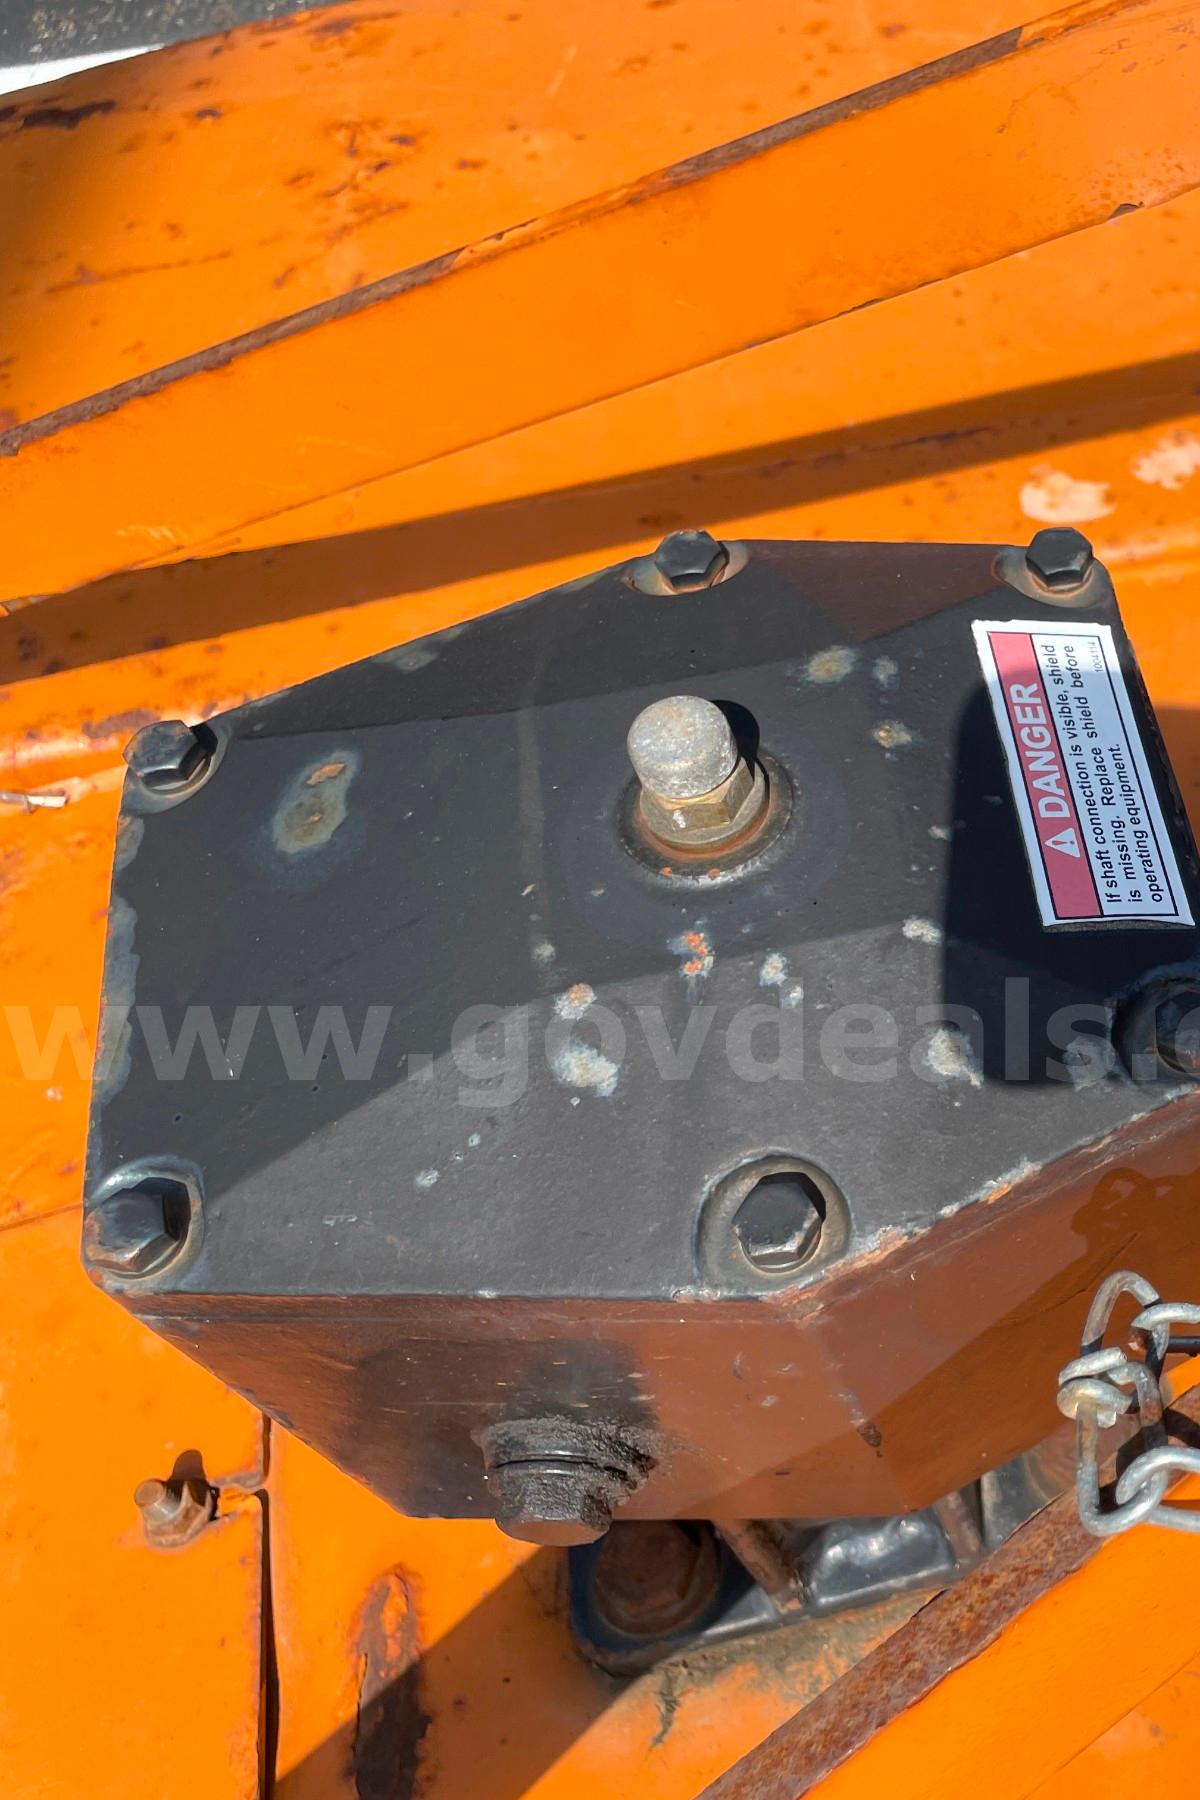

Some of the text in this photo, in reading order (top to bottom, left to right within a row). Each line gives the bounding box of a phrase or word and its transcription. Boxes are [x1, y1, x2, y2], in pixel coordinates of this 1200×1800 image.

[1010, 683, 1072, 819] DANGER
[1041, 644, 1122, 903] If shaft connection is visible, shield
[1064, 645, 1142, 902] is missing. Replace shield before
[1107, 744, 1164, 903] operating equipment.
